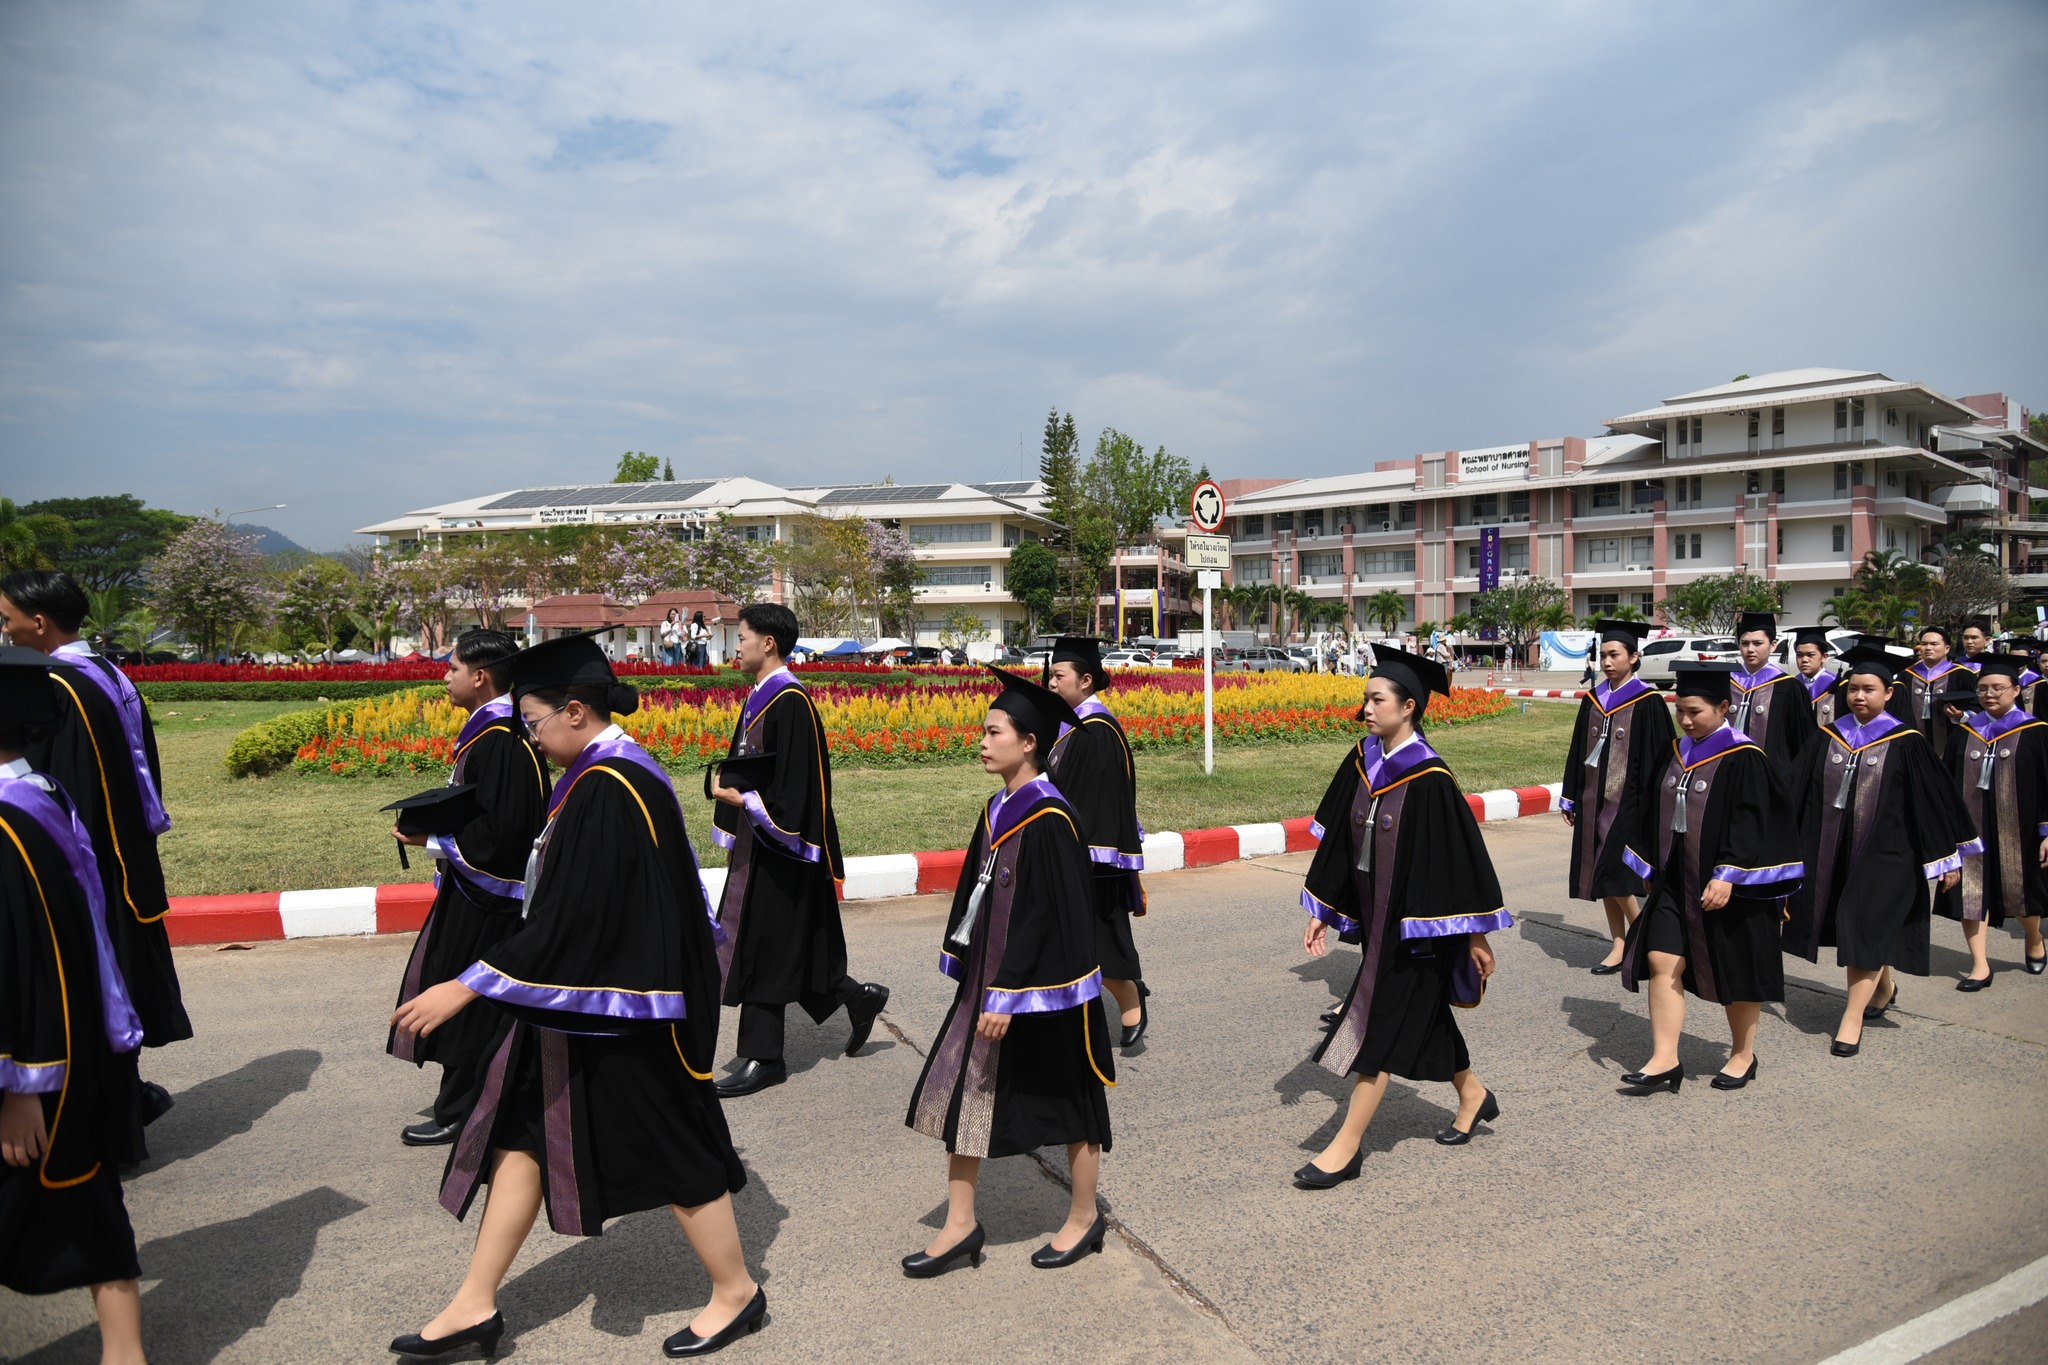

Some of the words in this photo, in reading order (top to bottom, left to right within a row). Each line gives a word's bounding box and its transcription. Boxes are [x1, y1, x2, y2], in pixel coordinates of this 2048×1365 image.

[1465, 464, 1488, 474] School
[1491, 463, 1499, 471] of
[1501, 461, 1529, 470] Nursing
[1189, 540, 1227, 552] ให้รถในวงเวียน
[1200, 553, 1218, 564] ไปก่อน
